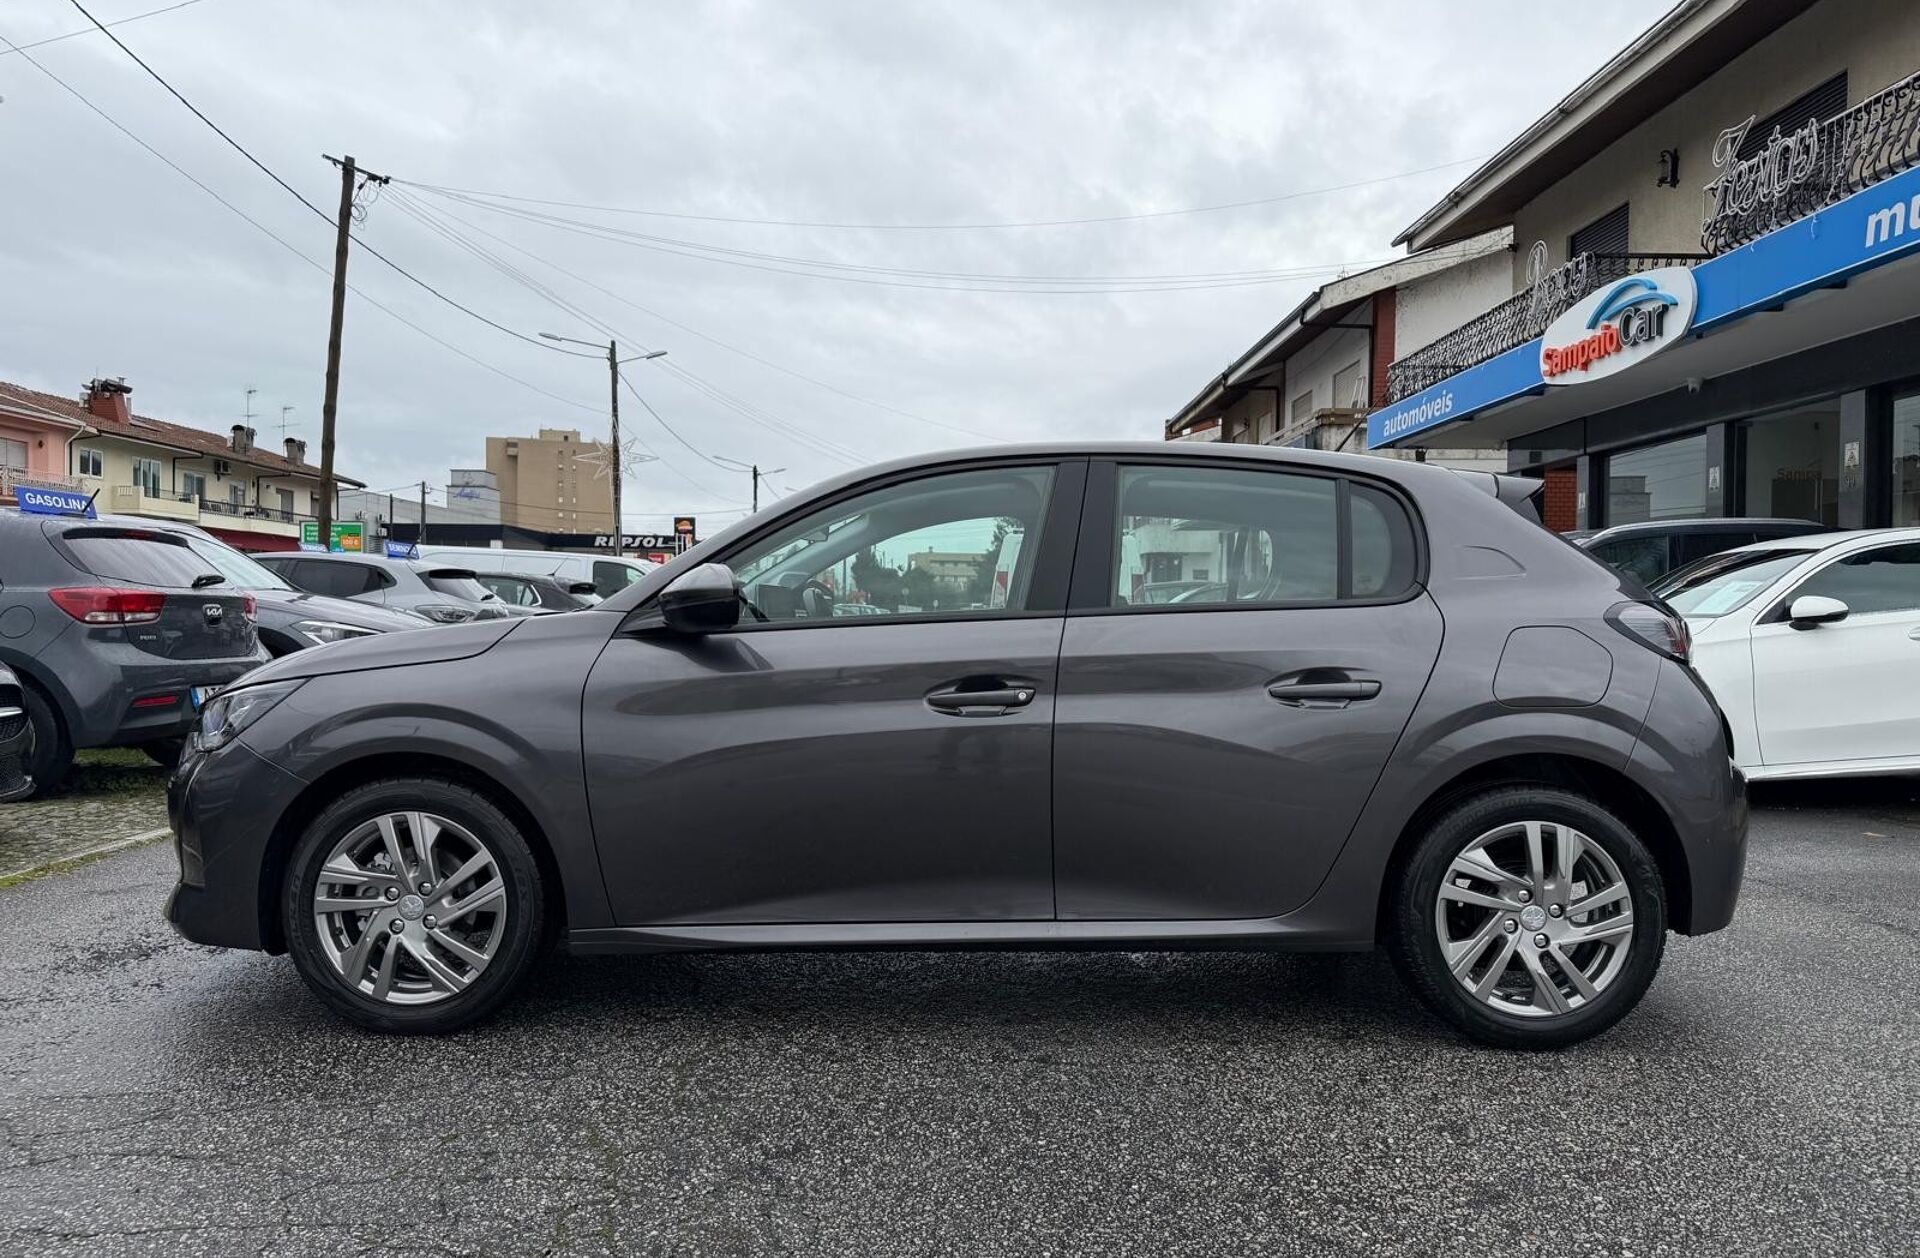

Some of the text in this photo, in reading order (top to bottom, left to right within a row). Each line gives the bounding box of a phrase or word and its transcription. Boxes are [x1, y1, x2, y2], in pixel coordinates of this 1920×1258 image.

[1383, 389, 1453, 437] automóveis
[25, 492, 91, 511] GASOLINA
[206, 608, 223, 616] KIA
